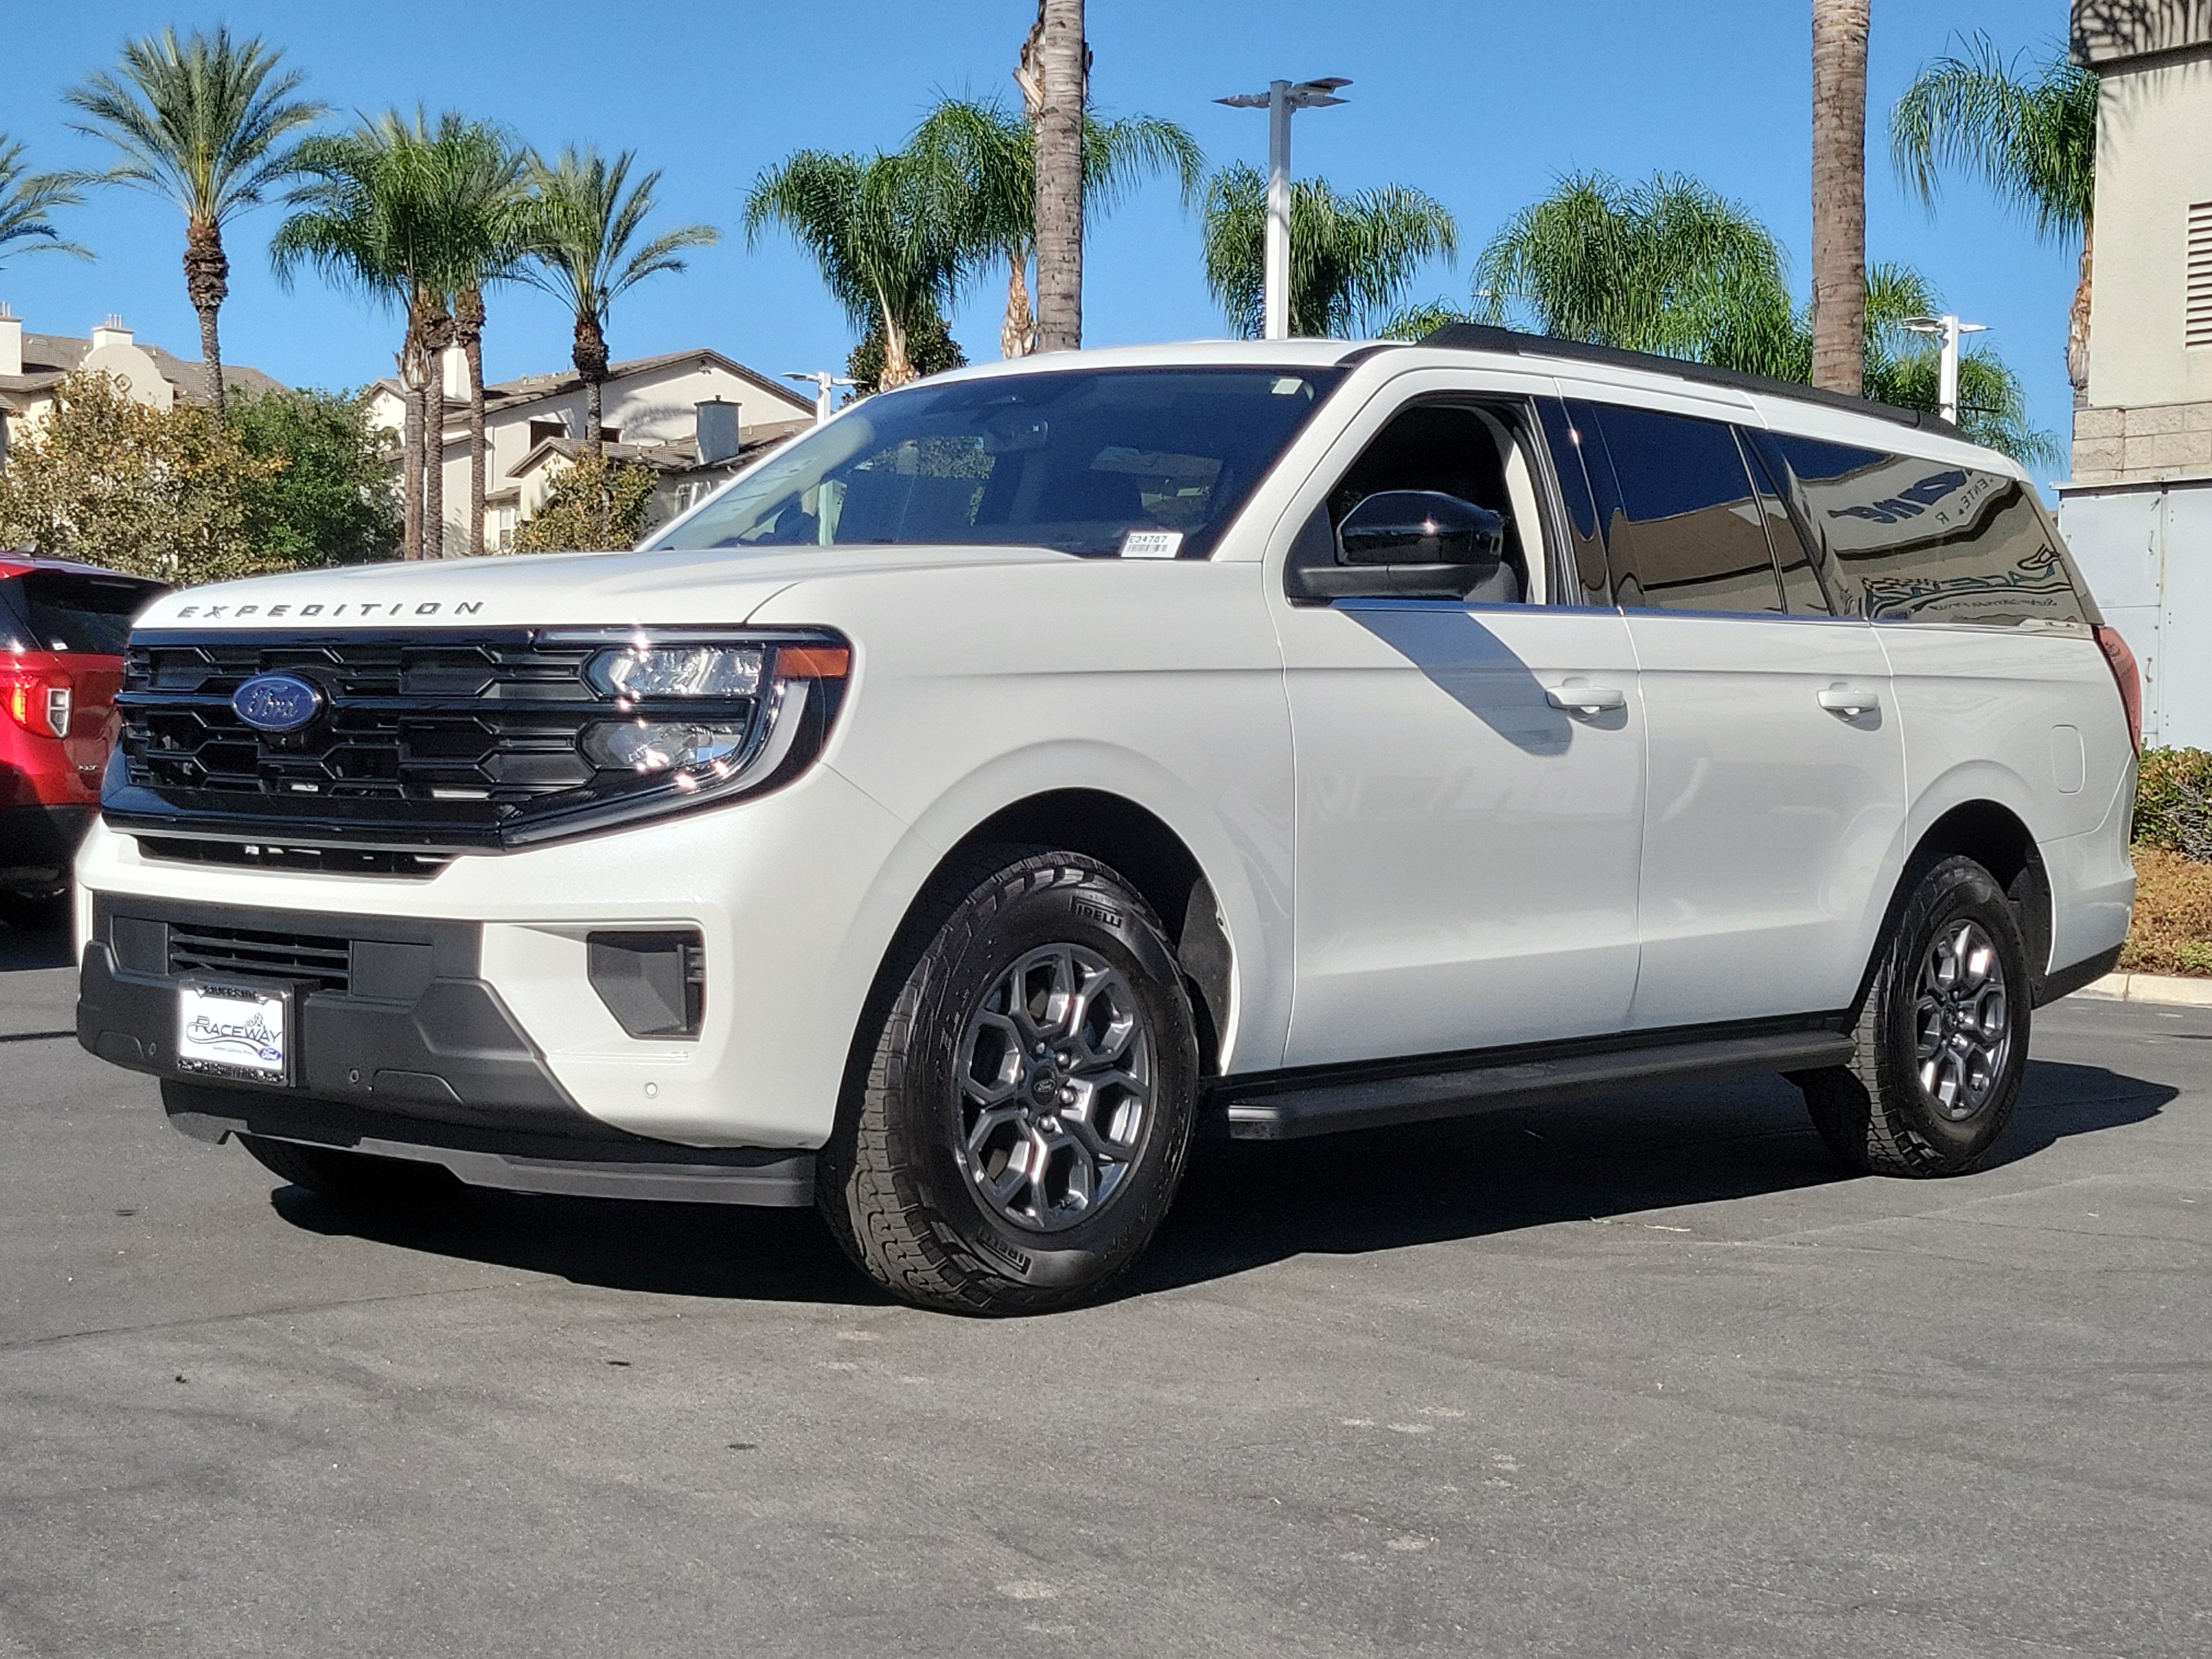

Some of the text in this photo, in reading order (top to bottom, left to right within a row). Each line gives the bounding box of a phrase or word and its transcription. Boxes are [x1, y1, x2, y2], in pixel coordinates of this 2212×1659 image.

[177, 601, 484, 619] EXPEDITION
[246, 684, 301, 718] Ford
[1070, 895, 1123, 928] PIRELLI
[192, 1015, 282, 1043] RACEWAY
